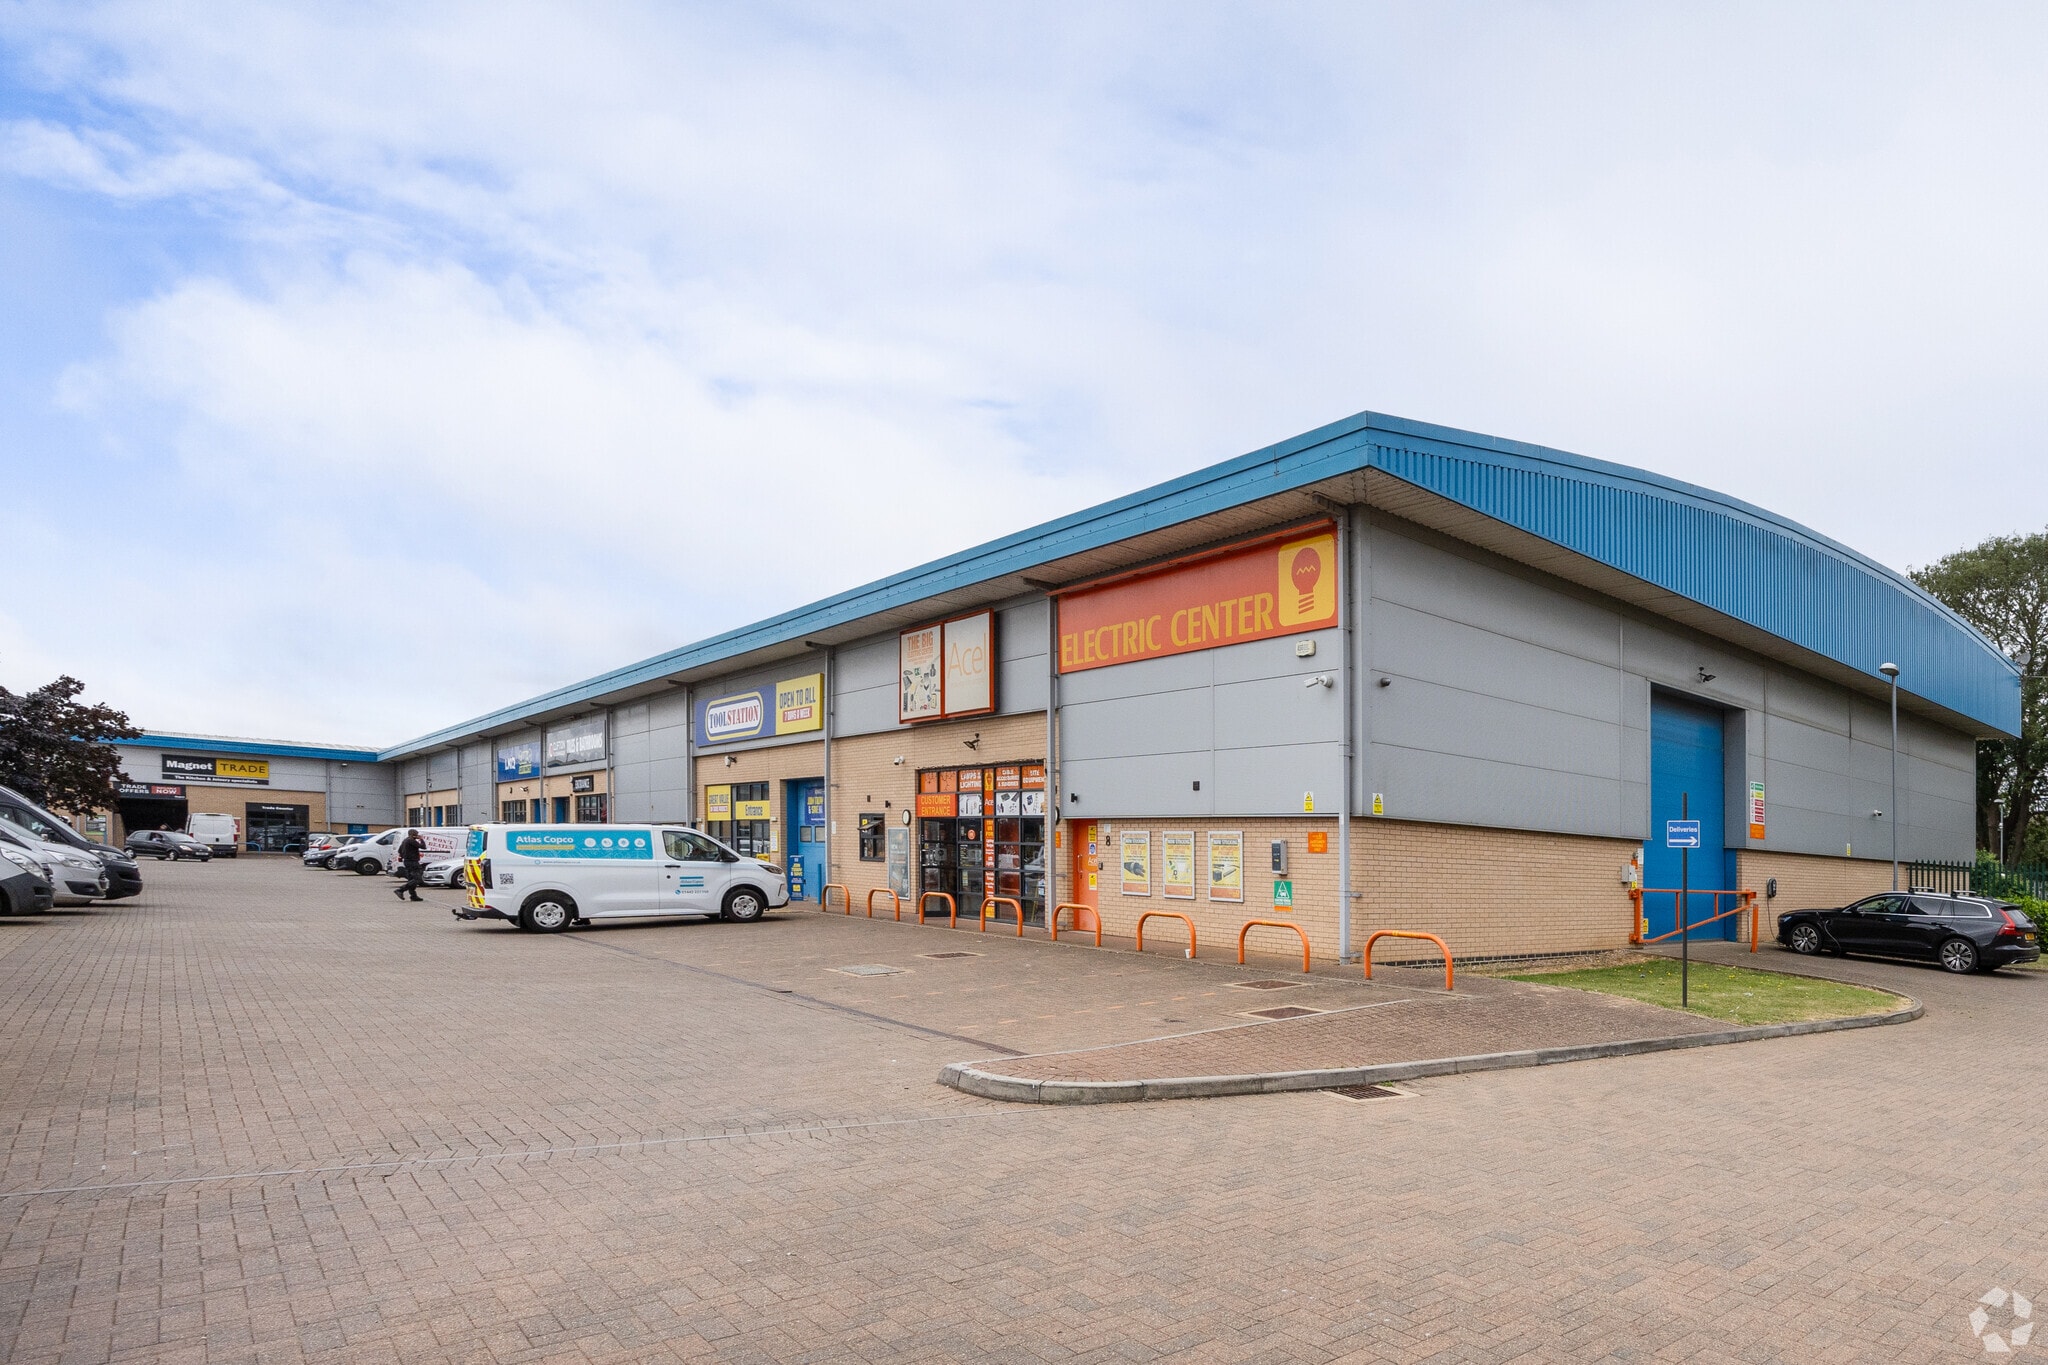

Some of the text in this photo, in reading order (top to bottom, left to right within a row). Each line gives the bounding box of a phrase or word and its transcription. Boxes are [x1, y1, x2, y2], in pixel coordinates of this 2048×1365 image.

[1062, 592, 1274, 667] ELECTRIC CENTER
[907, 631, 933, 651] THE BIG
[947, 632, 986, 679] Acel
[780, 686, 816, 709] OPEN TO ALL
[710, 704, 759, 729] TOOLSTATION
[166, 759, 266, 774] Magnet TRADE
[920, 795, 951, 805] CUSTOMER
[745, 804, 763, 816] Entrance
[921, 806, 951, 816] ENTRANCE
[516, 835, 574, 844] Atlas Copco
[1105, 835, 1111, 847] 8
